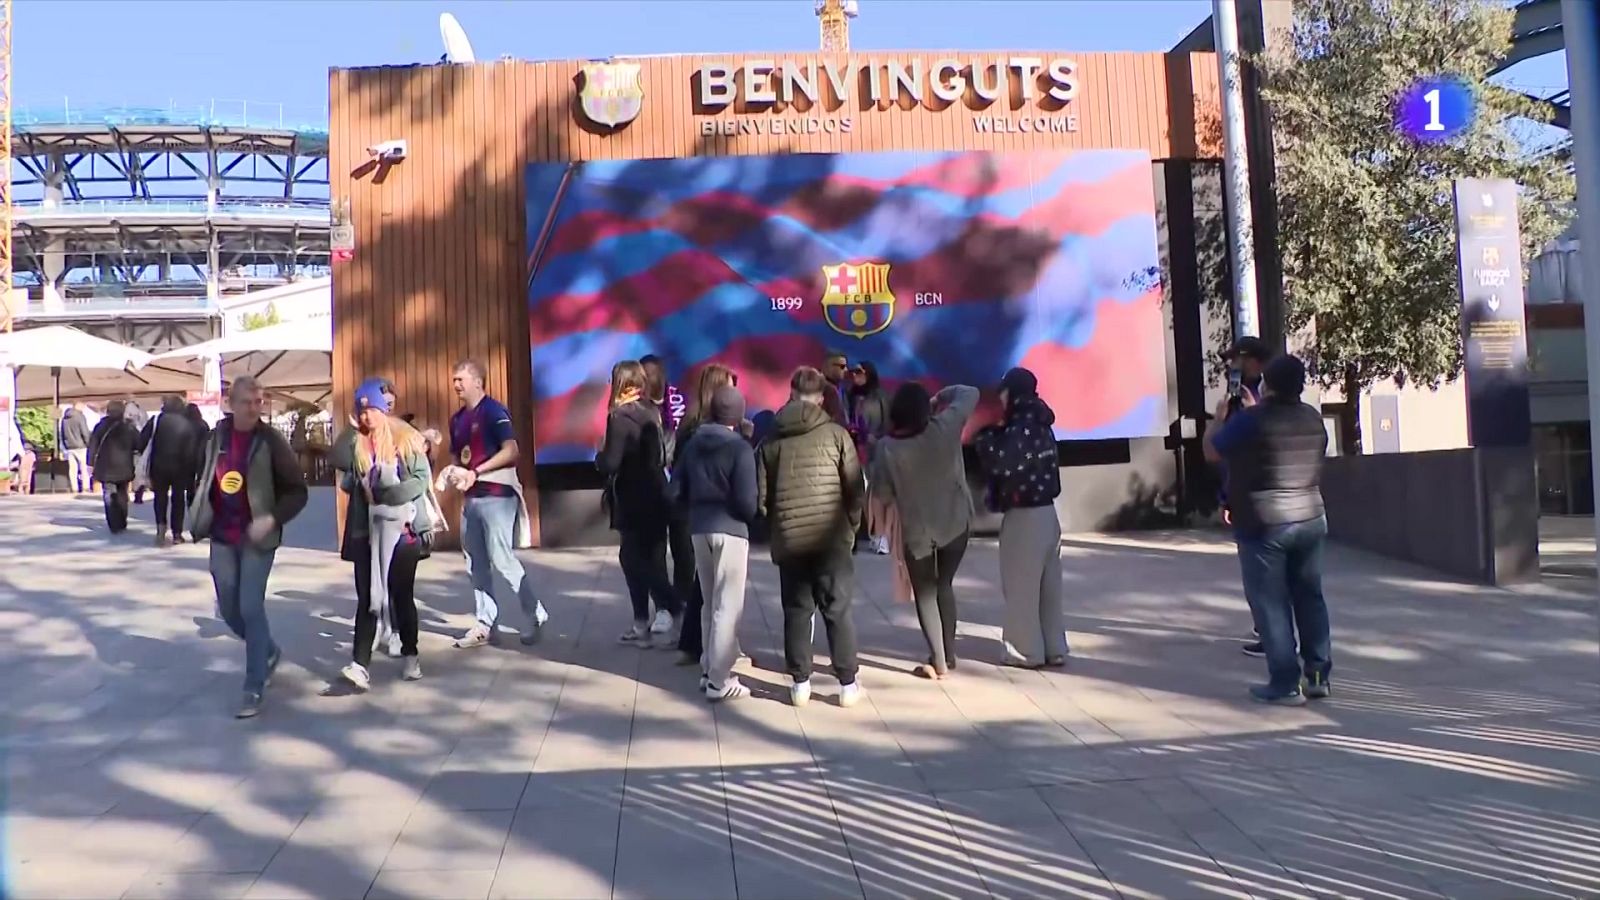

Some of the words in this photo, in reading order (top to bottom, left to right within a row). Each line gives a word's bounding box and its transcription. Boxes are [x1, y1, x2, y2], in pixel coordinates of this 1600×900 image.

[701, 57, 1079, 104] BENVINGUTS
[701, 117, 853, 137] BIENVENIDOS
[973, 116, 1078, 134] WELCOME
[770, 297, 803, 311] 1899
[844, 294, 872, 303] FCB
[915, 293, 943, 306] BCN
